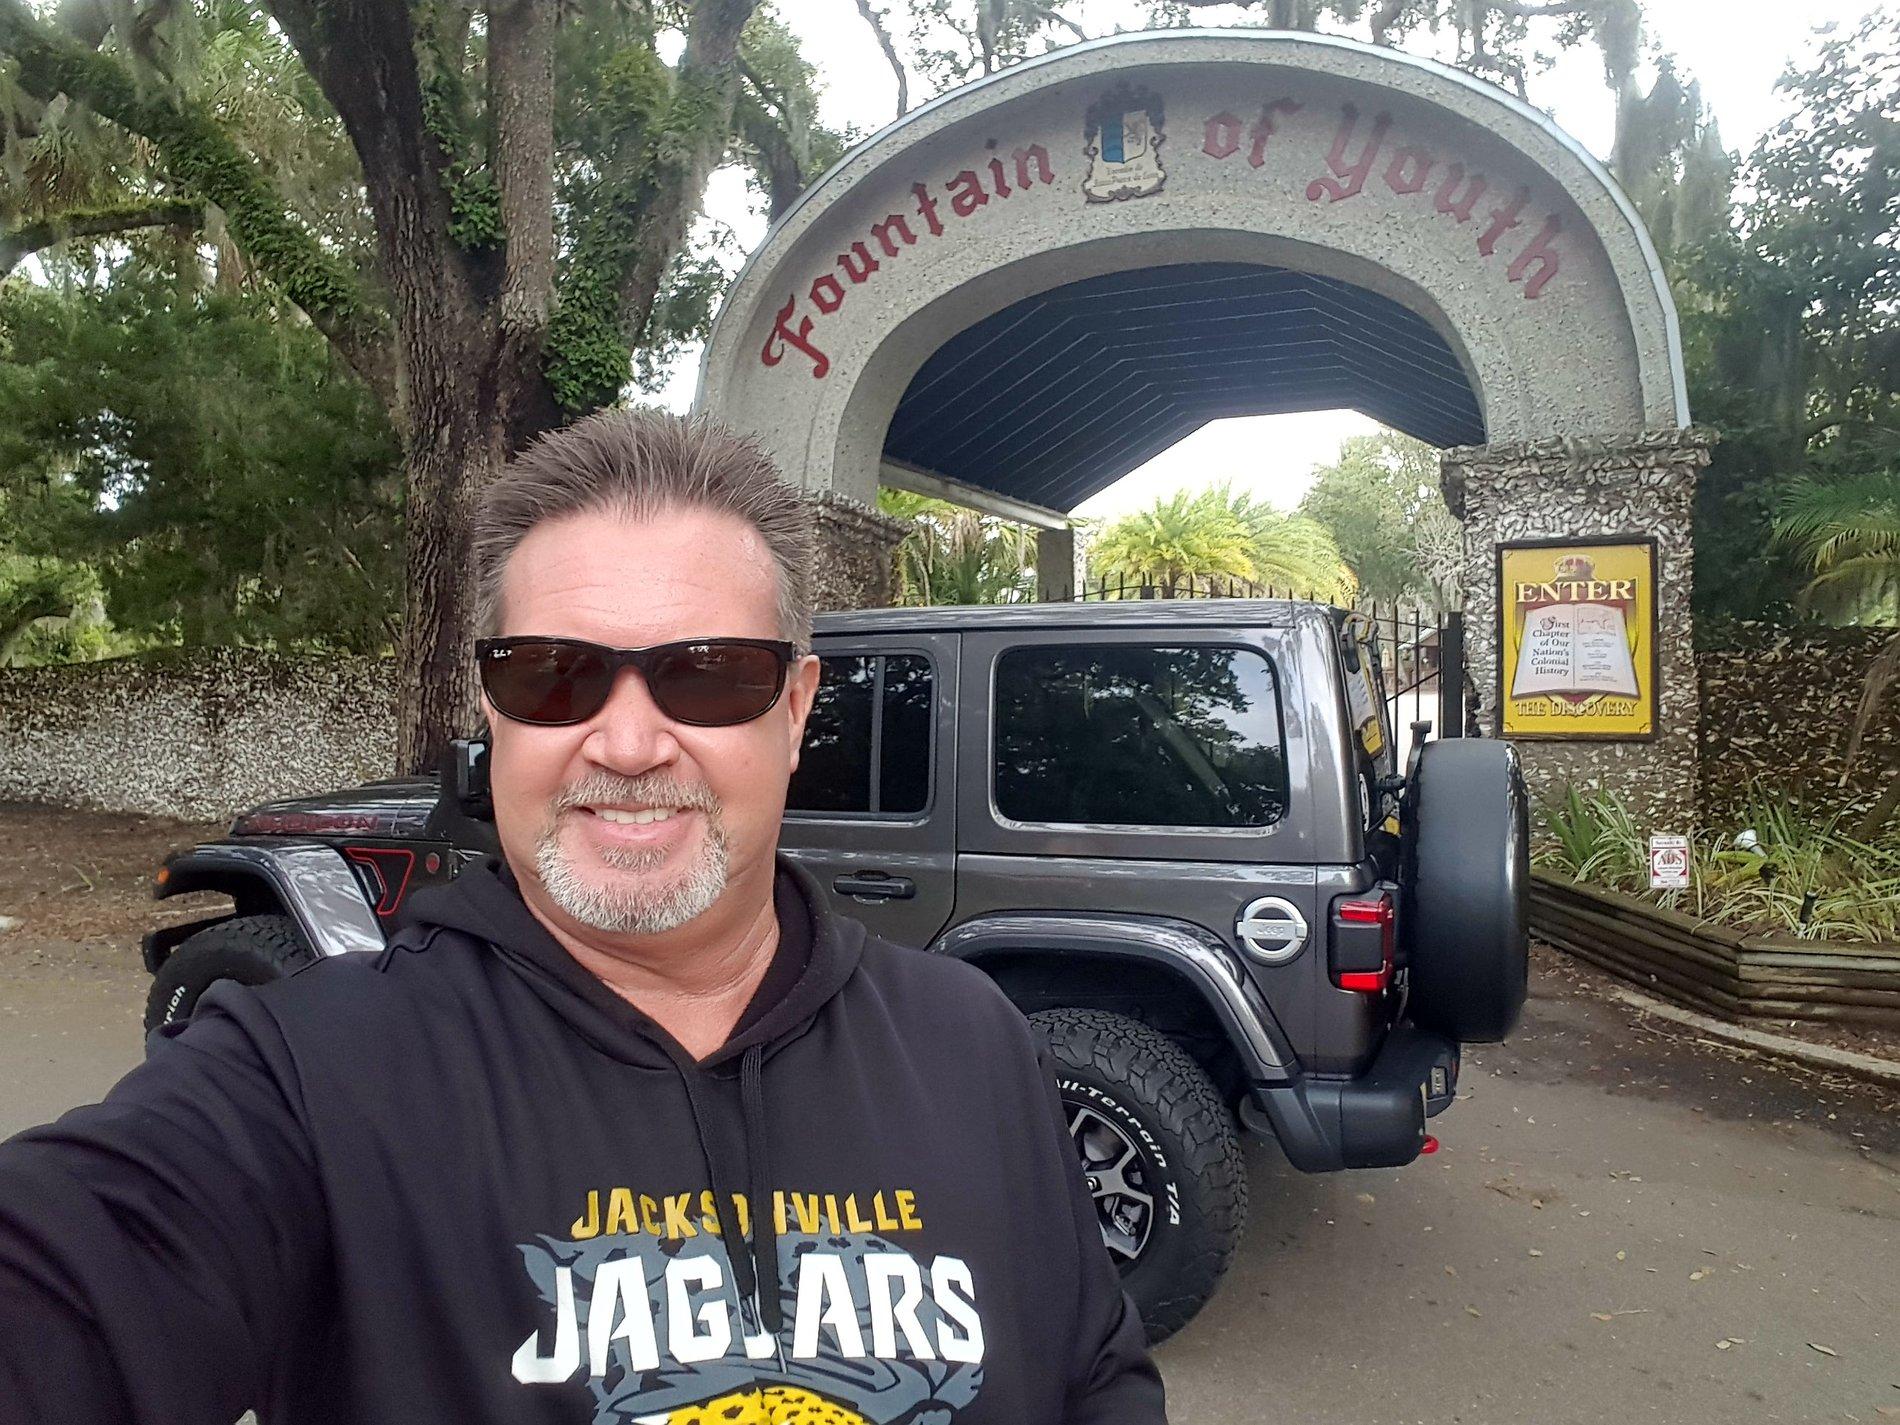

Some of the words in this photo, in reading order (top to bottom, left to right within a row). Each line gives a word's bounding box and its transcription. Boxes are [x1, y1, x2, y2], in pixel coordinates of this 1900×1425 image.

[761, 138, 1055, 379] Fountain
[1202, 97, 1302, 168] of
[1306, 103, 1562, 298] Youth
[1516, 579, 1633, 603] ENTER
[1540, 616, 1570, 631] First
[1532, 629, 1570, 638] Chapter
[1540, 639, 1549, 647] of
[1552, 639, 1570, 647] Our
[1533, 648, 1570, 657] Nation's
[1531, 657, 1569, 666] Colonial
[1535, 667, 1570, 677] History
[1516, 702, 1546, 716] THE
[1551, 701, 1638, 717] DISCOVERY
[1255, 925, 1285, 938] Jeep
[1166, 1181, 1181, 1226] T/A
